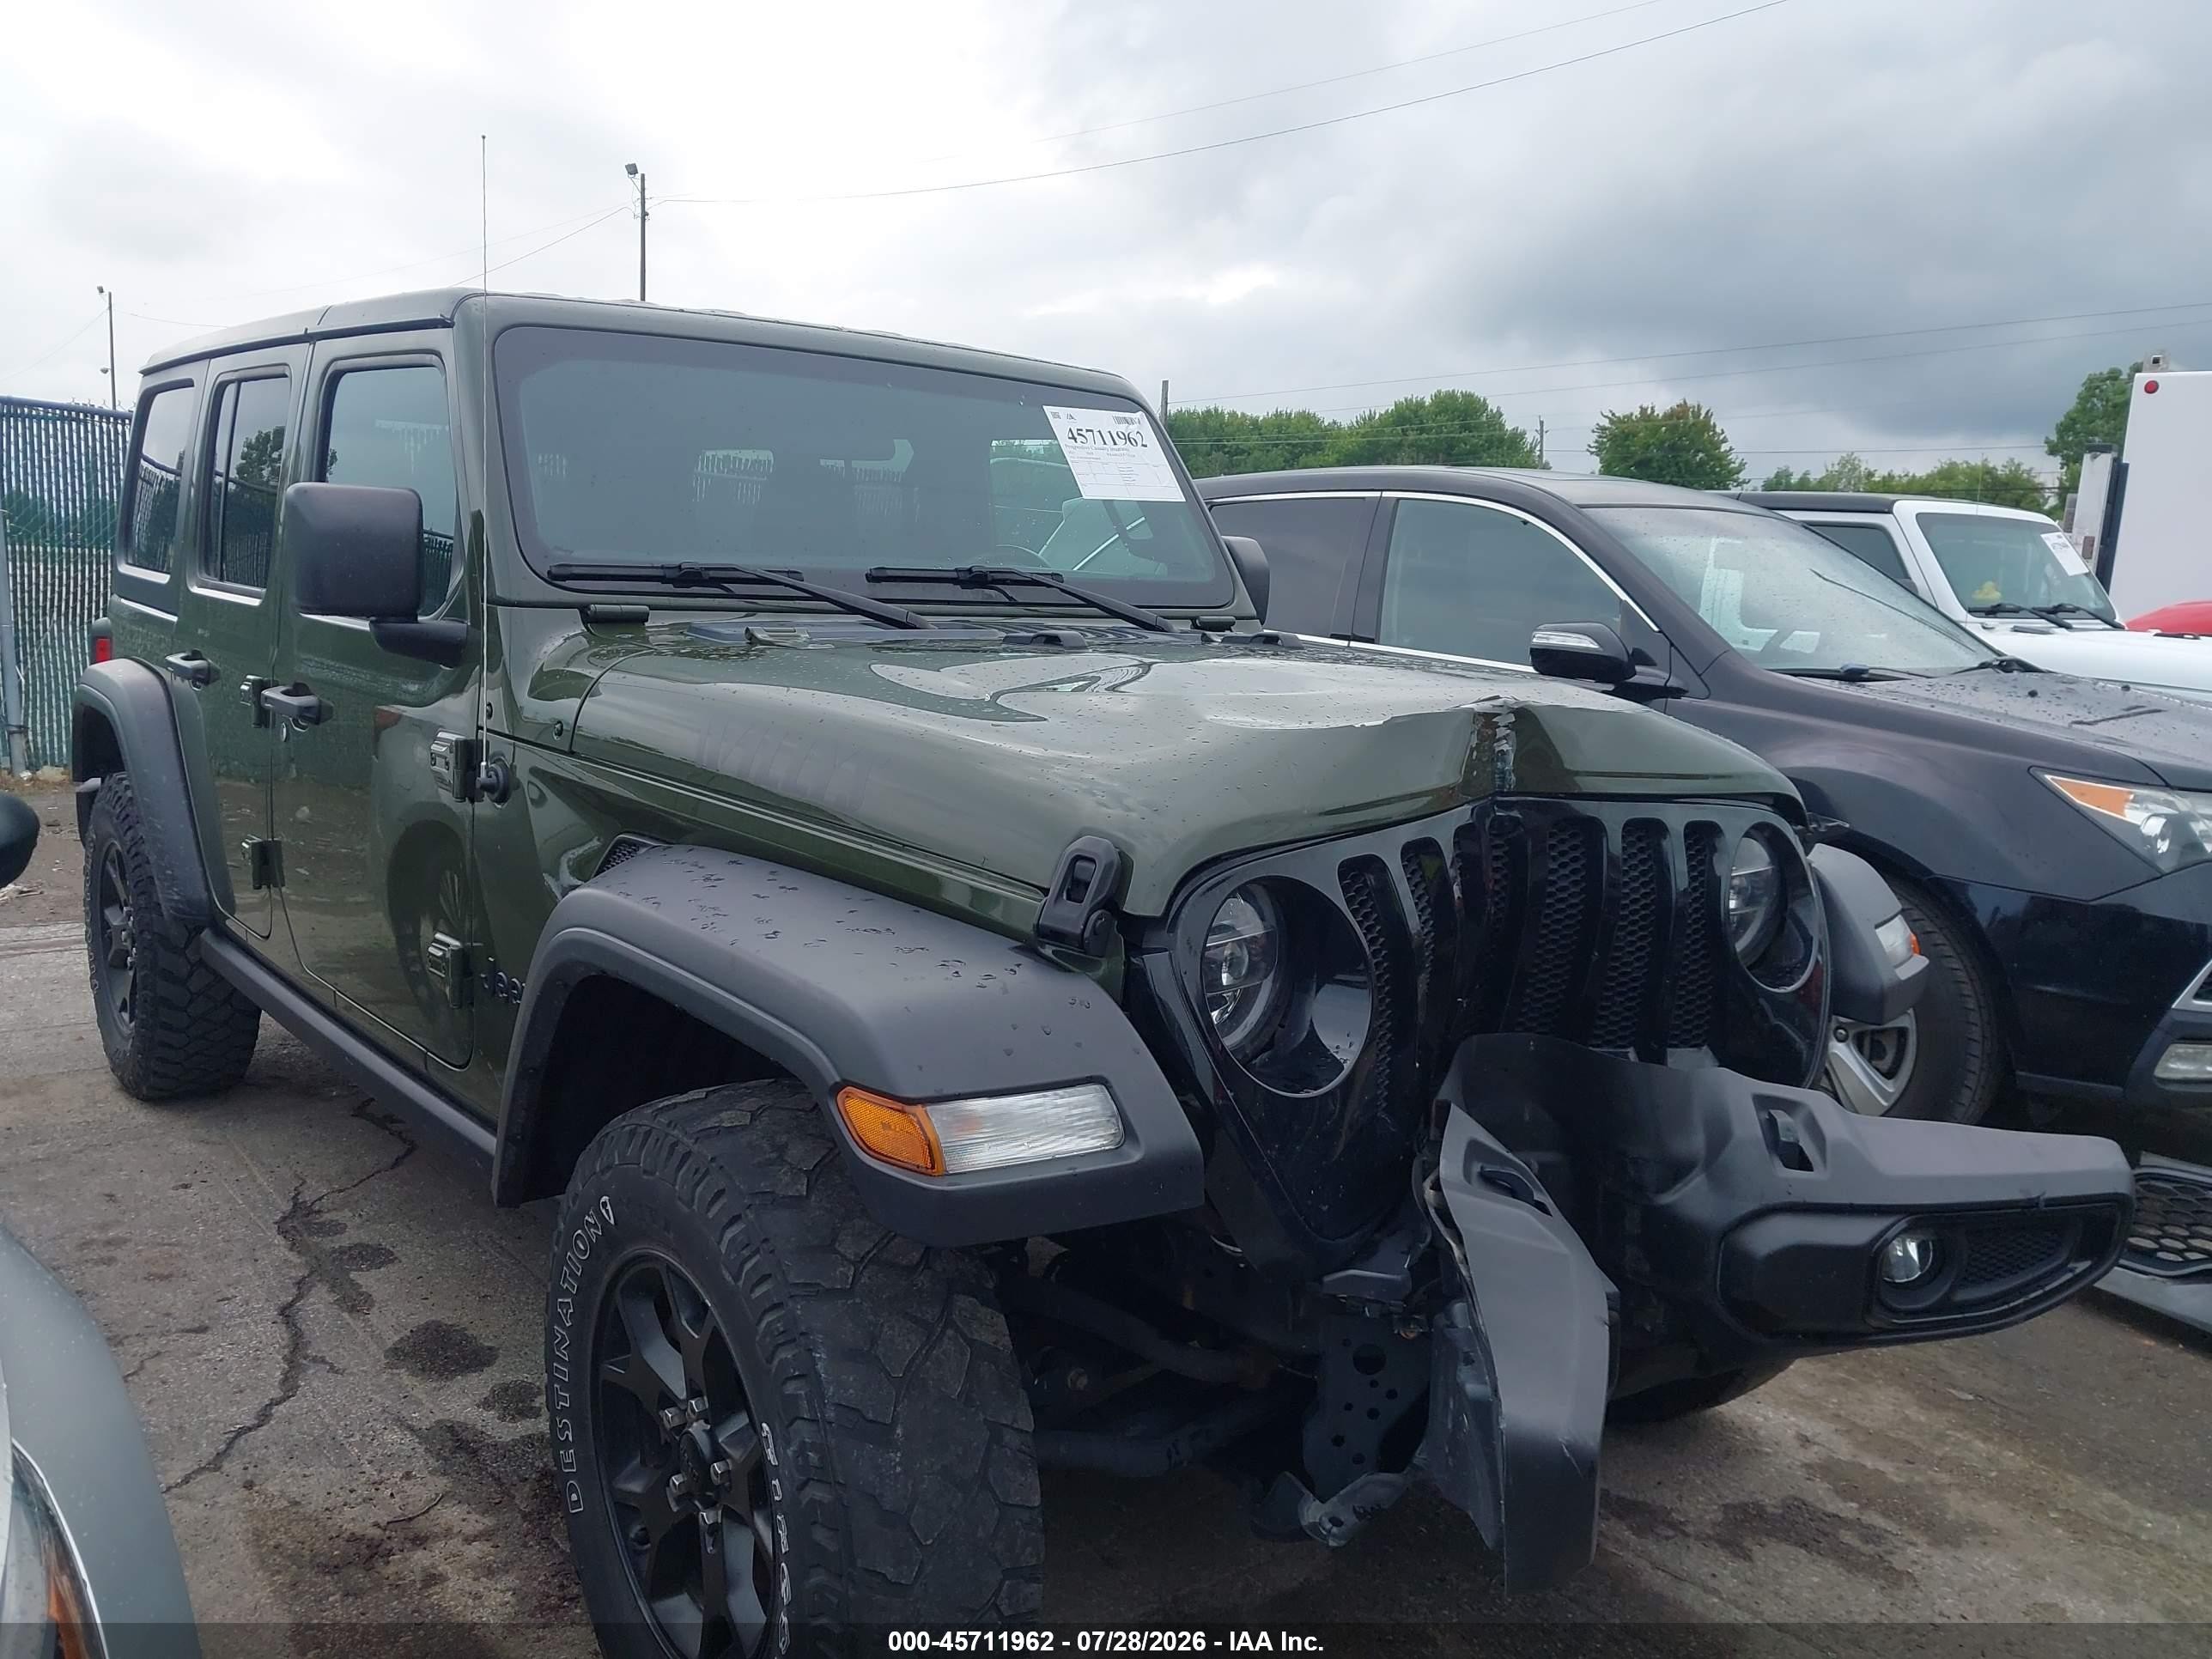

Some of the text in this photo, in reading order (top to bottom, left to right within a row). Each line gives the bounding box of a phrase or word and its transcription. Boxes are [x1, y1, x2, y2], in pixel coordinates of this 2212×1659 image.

[1067, 428, 1148, 447] 45711962
[480, 957, 526, 1004] Jee
[553, 1209, 602, 1514] DESTINATION
